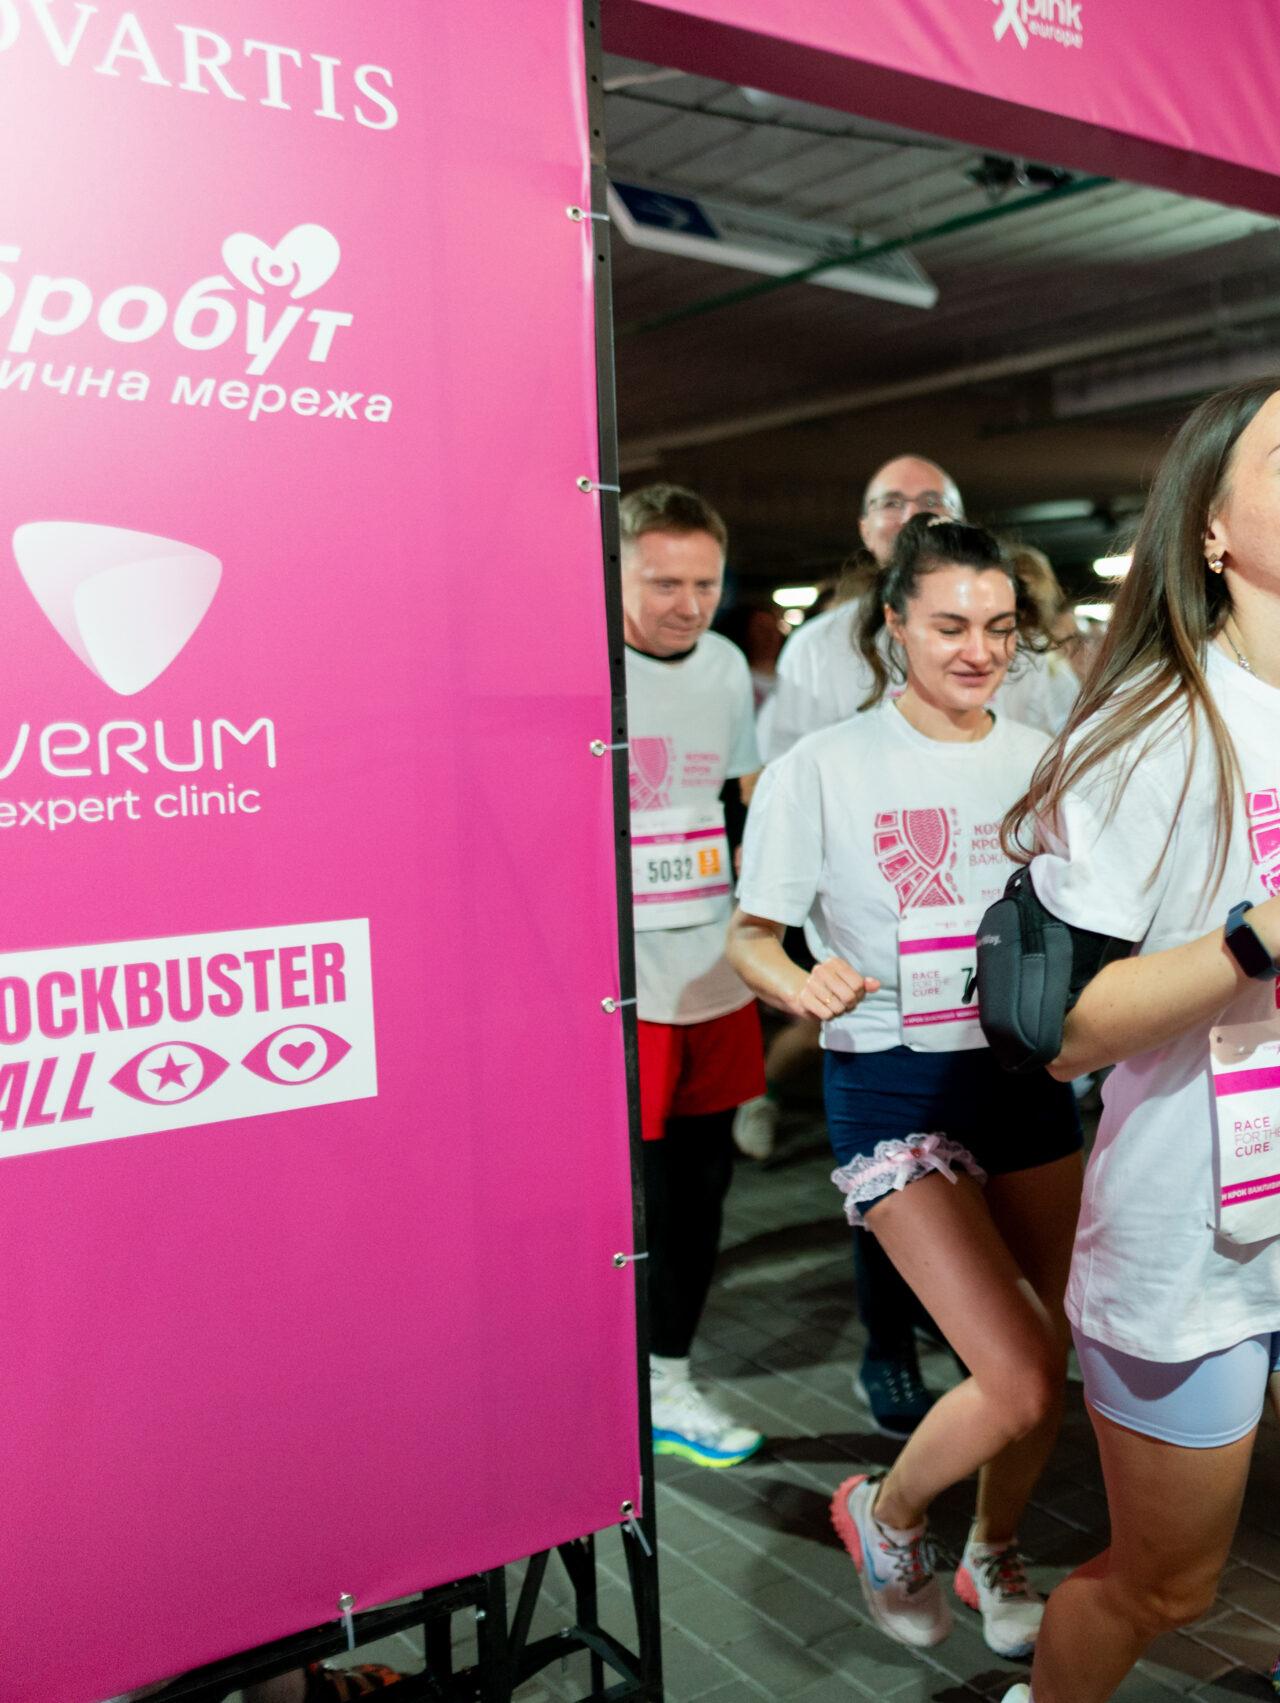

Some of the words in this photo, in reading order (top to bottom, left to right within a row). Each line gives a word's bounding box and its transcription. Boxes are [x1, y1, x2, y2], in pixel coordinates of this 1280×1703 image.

[170, 373, 394, 423] мережа
[0, 788, 141, 832] expert
[153, 782, 262, 818] clinic
[971, 838, 999, 850] КРО
[647, 857, 693, 884] 5032
[912, 971, 940, 980] RACE
[0, 941, 348, 1046] OCKBUSTER
[912, 988, 941, 998] CURE
[1234, 1115, 1271, 1132] RACE
[1234, 1131, 1262, 1146] FOR
[1235, 1141, 1272, 1158] CURE
[1227, 1188, 1248, 1200] КРОК
